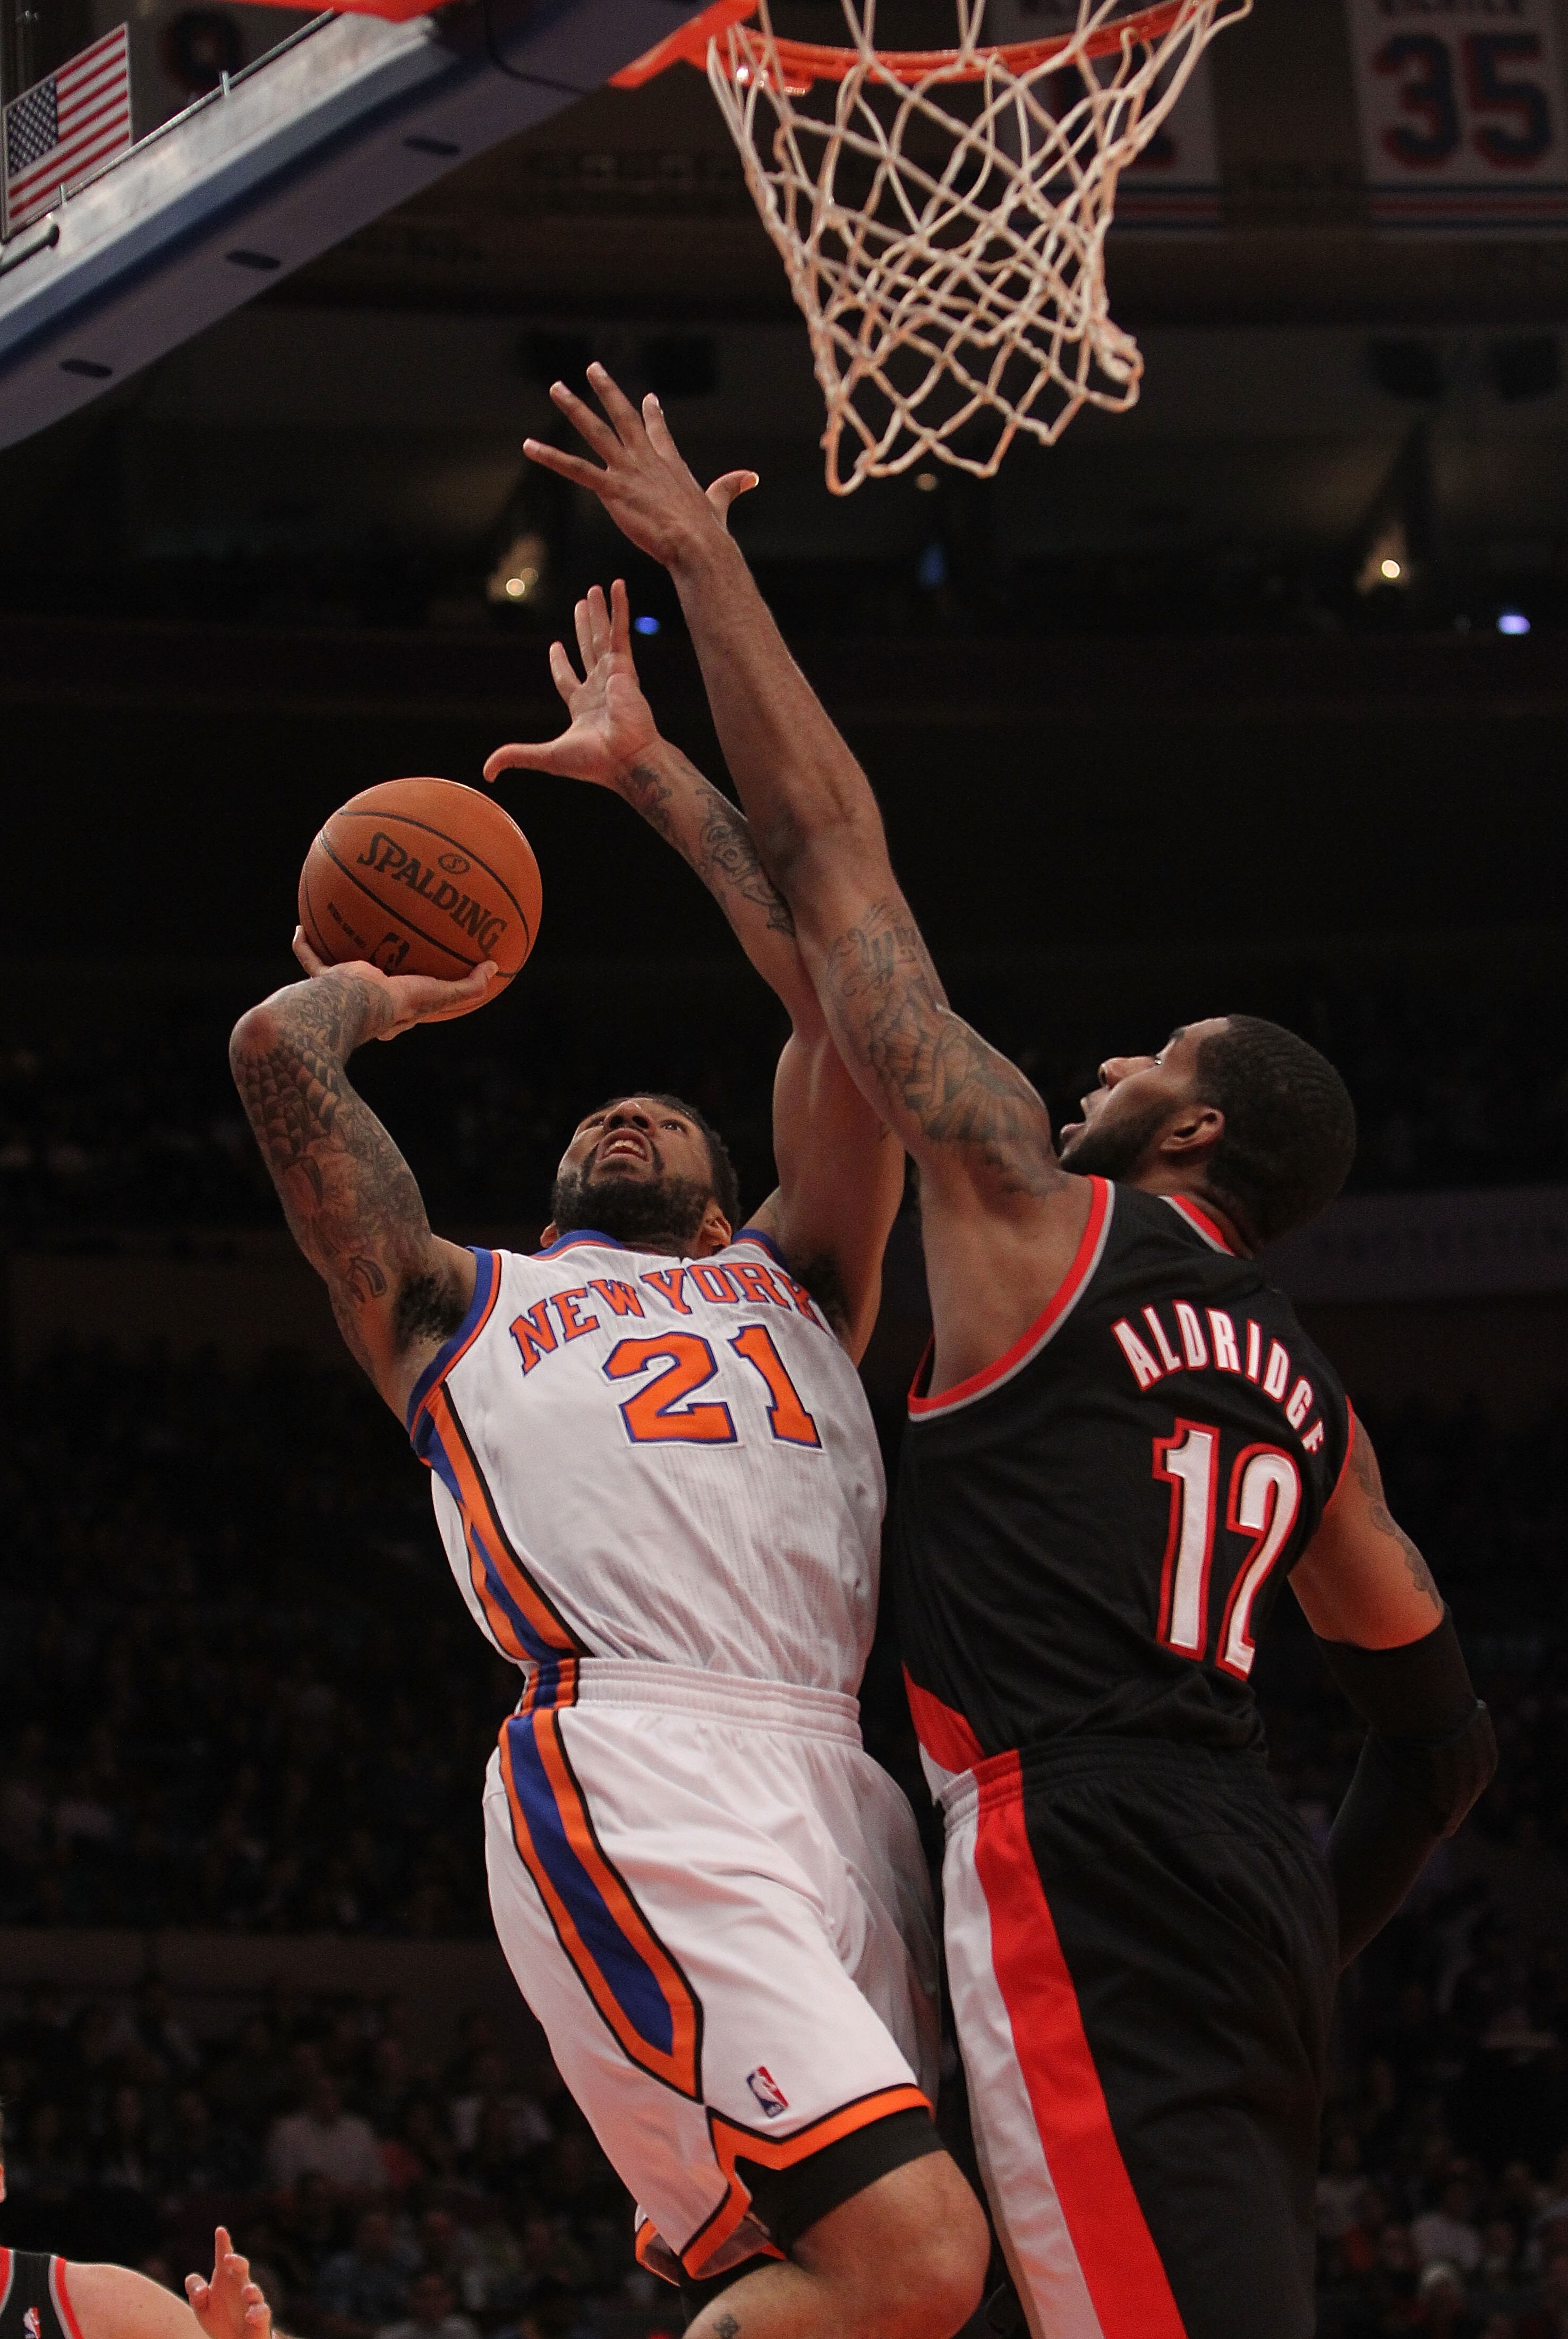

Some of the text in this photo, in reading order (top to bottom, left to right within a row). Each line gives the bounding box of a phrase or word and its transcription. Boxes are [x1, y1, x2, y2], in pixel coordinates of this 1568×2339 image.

[1370, 31, 1554, 170] 35
[357, 831, 507, 959] SPALDING
[509, 1261, 830, 1377] NEW YORK
[1111, 1297, 1325, 1456] ALDRIDGE
[602, 1324, 822, 1449] 21
[1152, 1415, 1303, 1681] 12
